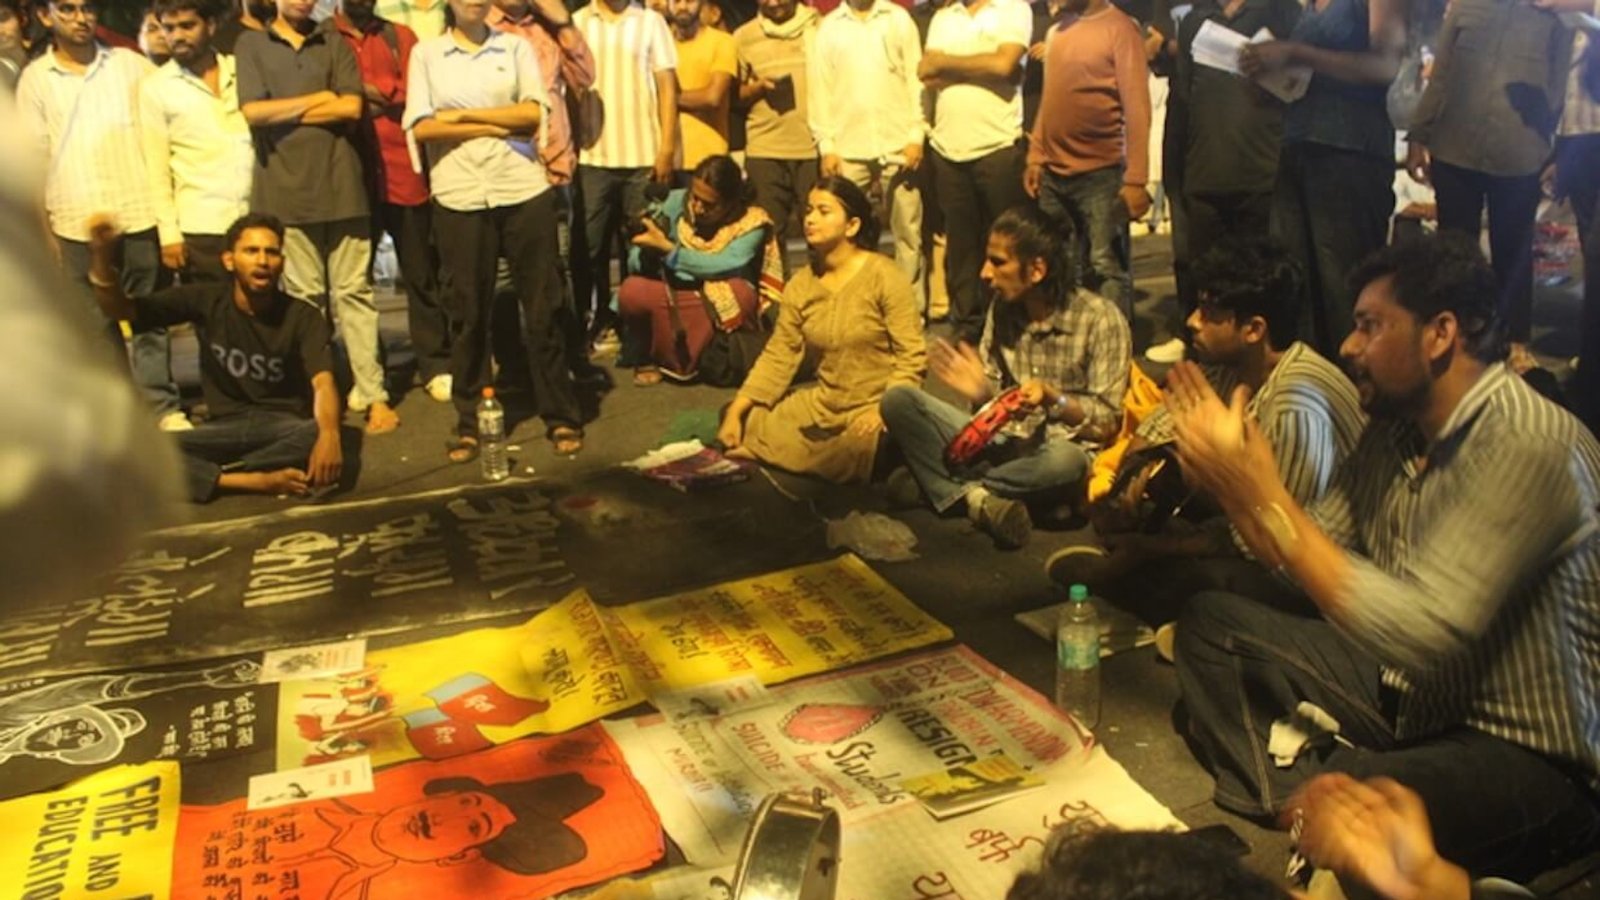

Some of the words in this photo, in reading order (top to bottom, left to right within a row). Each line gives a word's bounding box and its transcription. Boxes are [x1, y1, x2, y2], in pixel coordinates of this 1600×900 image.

[731, 722, 786, 773] SUICIDE
[90, 774, 162, 842] FREE
[20, 795, 88, 900] EDUCATIO
[84, 852, 123, 892] AND
